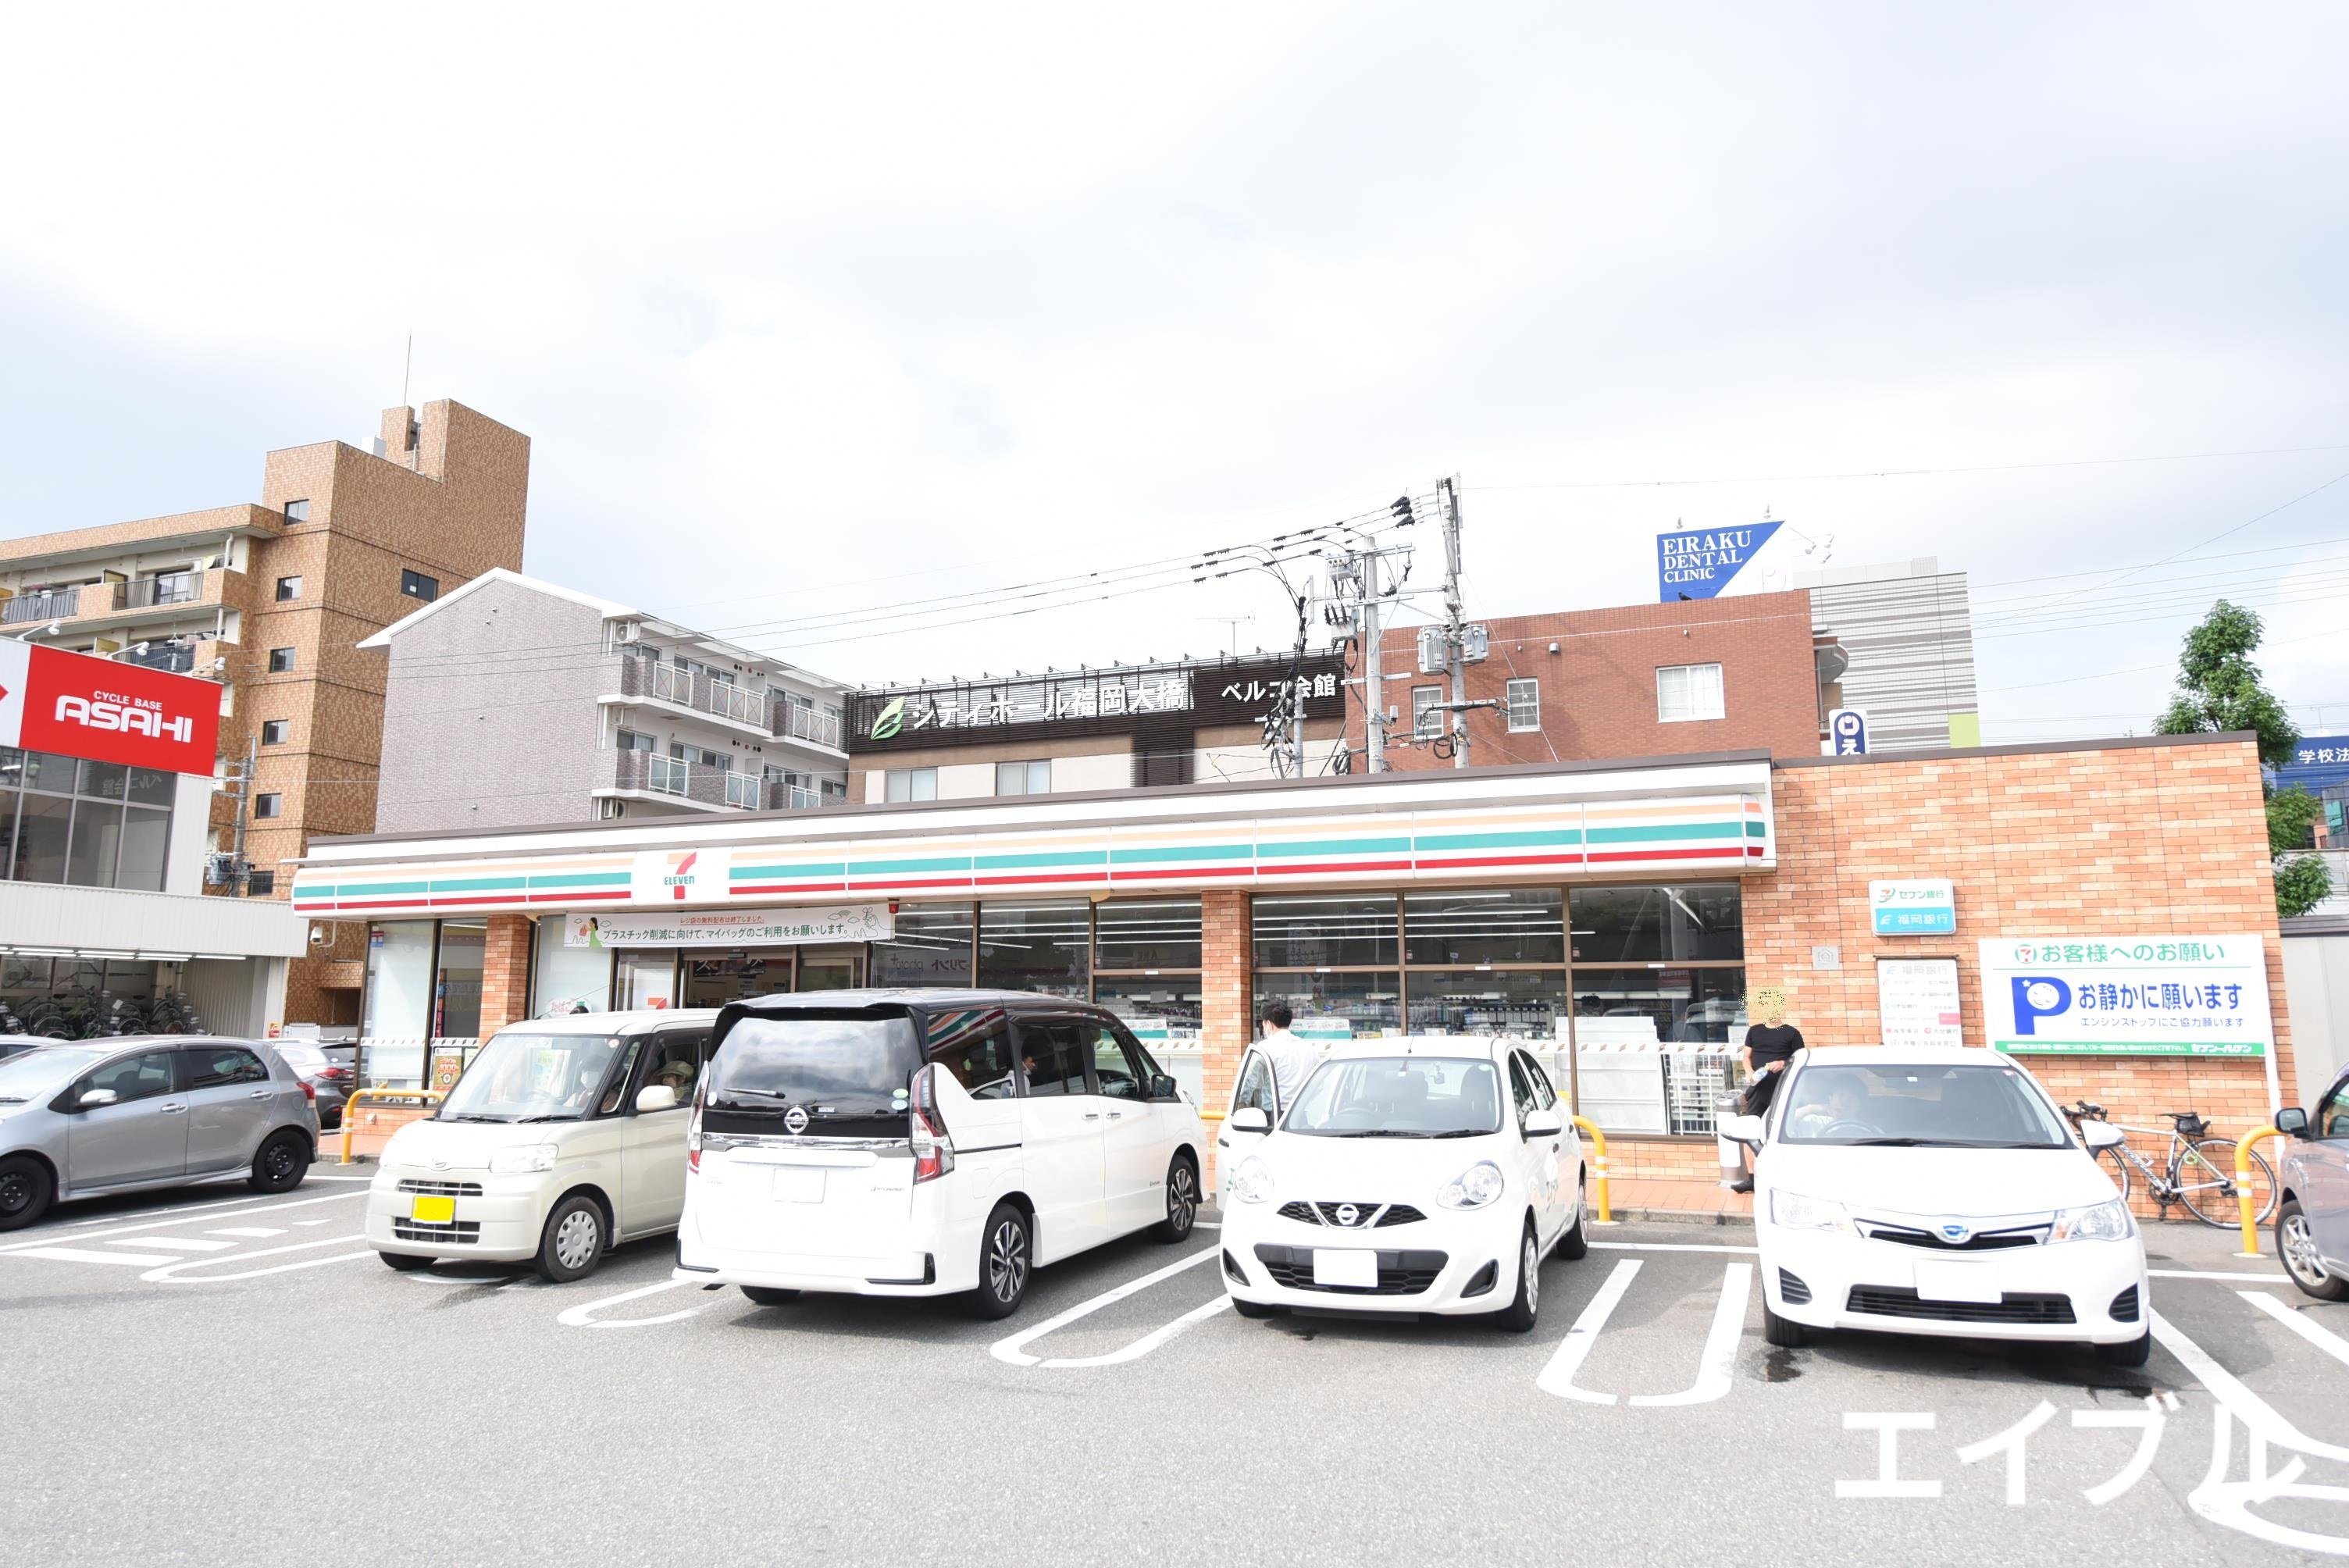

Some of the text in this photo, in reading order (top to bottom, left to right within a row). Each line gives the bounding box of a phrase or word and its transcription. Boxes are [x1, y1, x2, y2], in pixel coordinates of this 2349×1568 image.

[1663, 529, 1752, 556] EIRAKU
[1663, 549, 1743, 571] DENTAL
[1663, 568, 1716, 583] CLINIC
[93, 690, 162, 711] CYCLE BASE
[912, 678, 1186, 729] シティホール福岡大橋
[55, 695, 193, 743] ASAHI
[1898, 914, 1950, 925] 福岡銀行
[604, 923, 848, 940] プラスチック削減に向けて、マイバッグのご利用をお願いします。
[2041, 943, 2226, 964] お客様へのお願い
[2078, 983, 2243, 1010] お静かに願います
